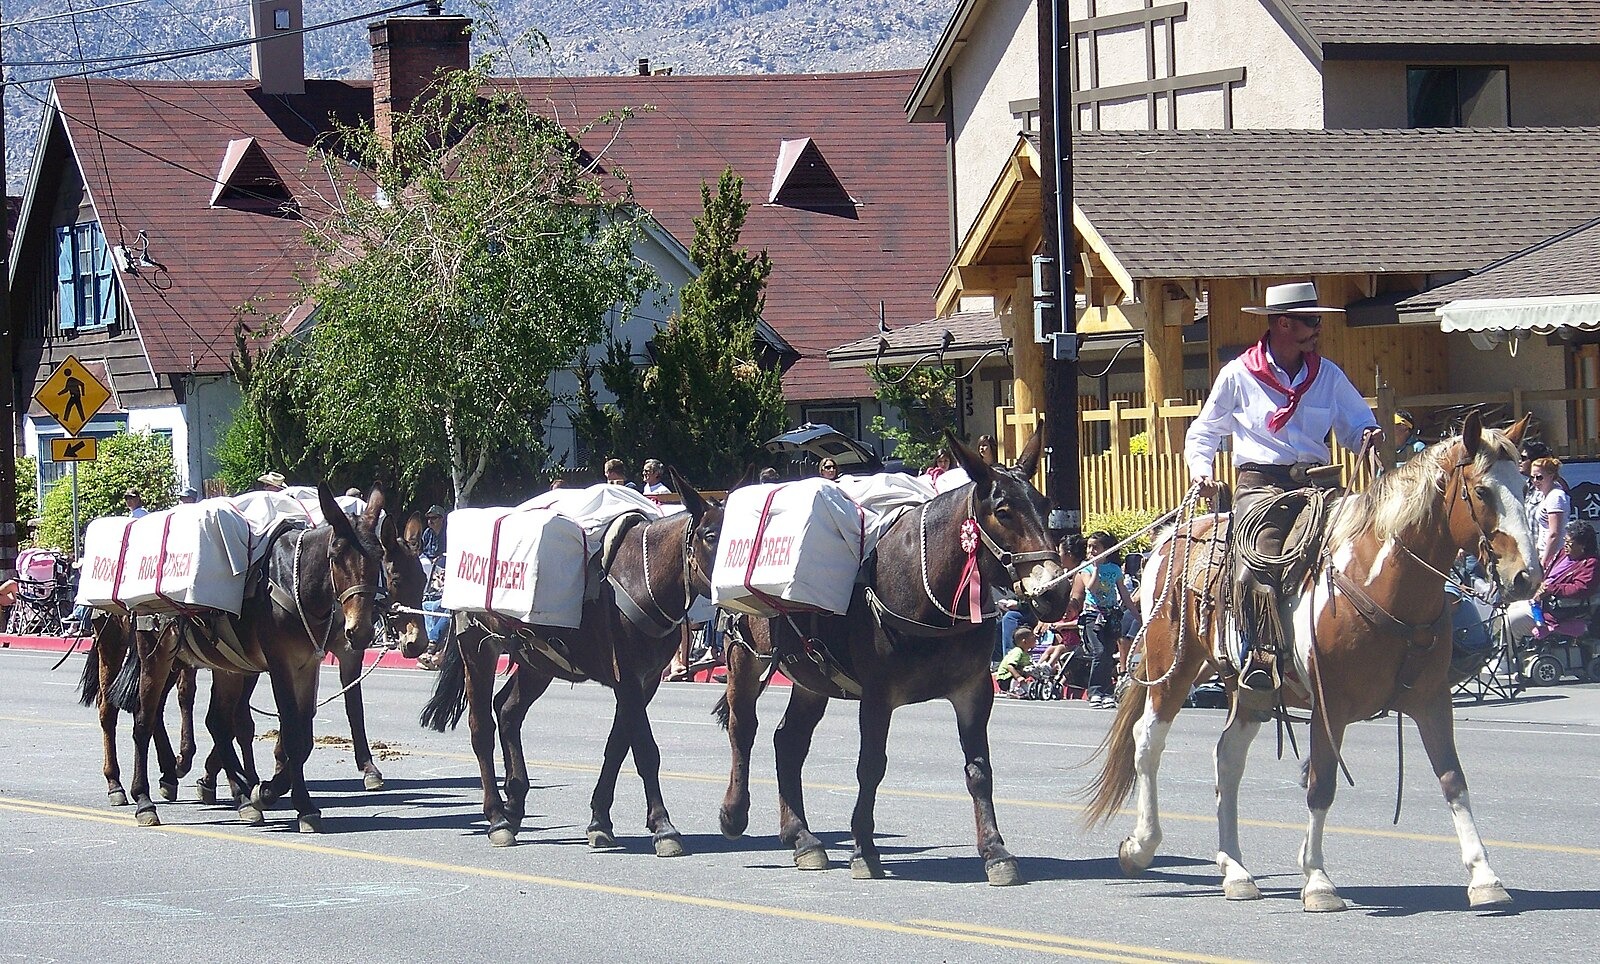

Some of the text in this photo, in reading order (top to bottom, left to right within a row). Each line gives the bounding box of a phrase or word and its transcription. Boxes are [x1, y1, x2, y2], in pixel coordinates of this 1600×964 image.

[138, 554, 160, 580] ROC
[758, 535, 795, 567] CREEK
[457, 550, 529, 591] ROCK CREEK
